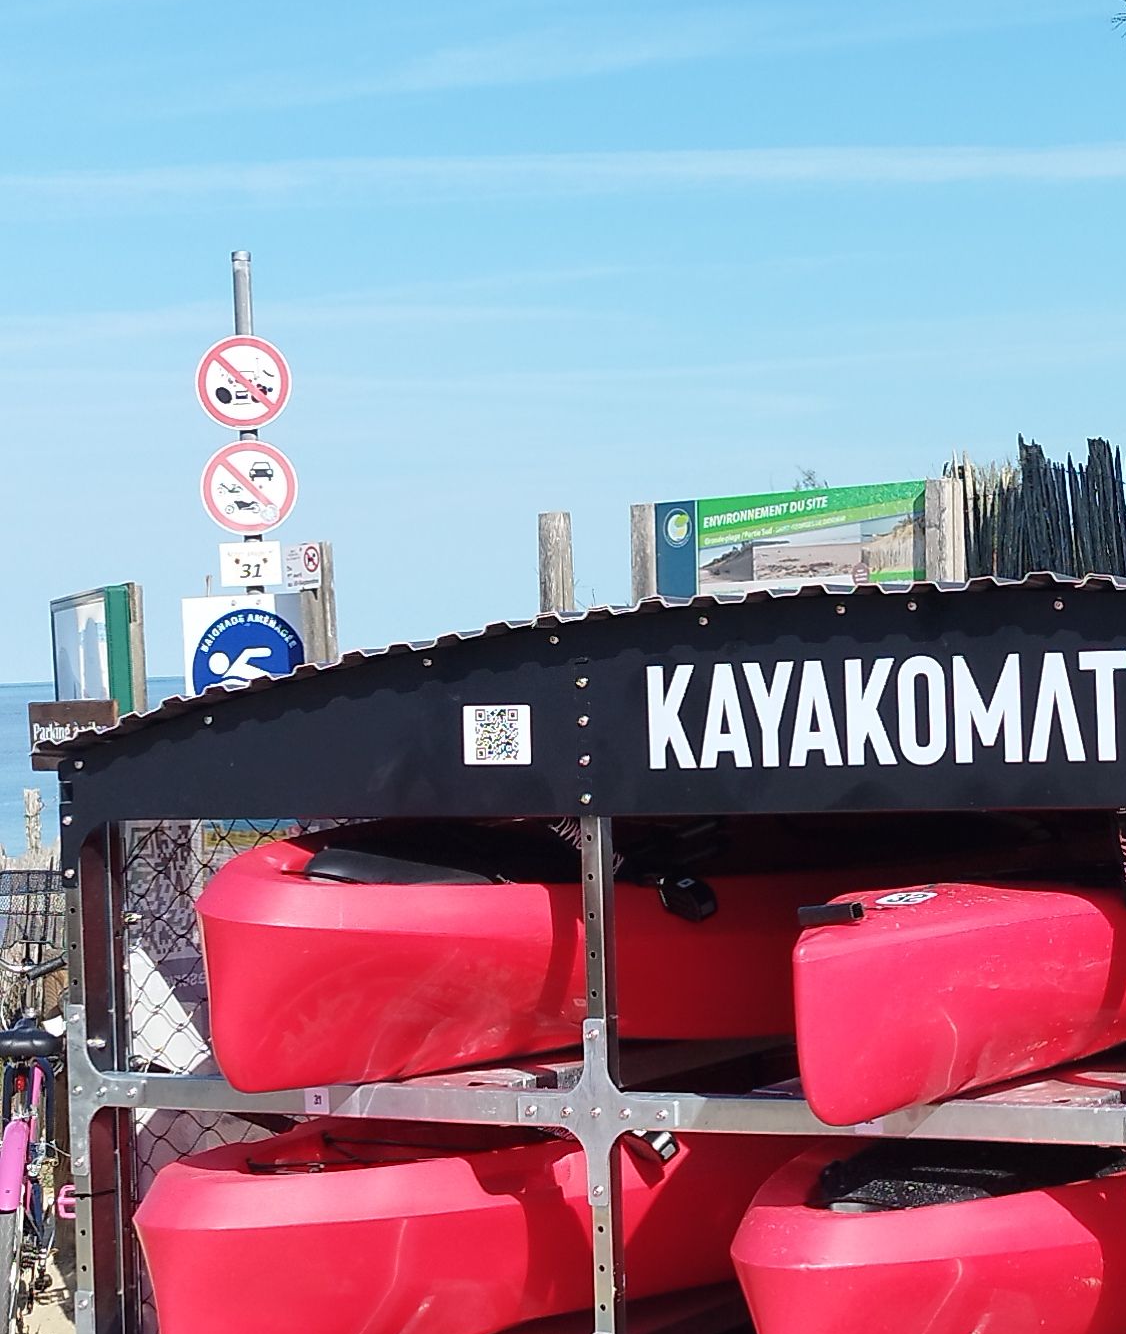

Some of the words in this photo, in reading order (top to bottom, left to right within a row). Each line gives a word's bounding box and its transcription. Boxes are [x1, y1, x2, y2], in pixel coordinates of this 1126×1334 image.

[703, 503, 789, 528] ENVIRONNEMENT
[789, 500, 805, 514] DU
[806, 496, 829, 511] SITE
[240, 563, 262, 579] 31
[33, 720, 71, 742] Parking
